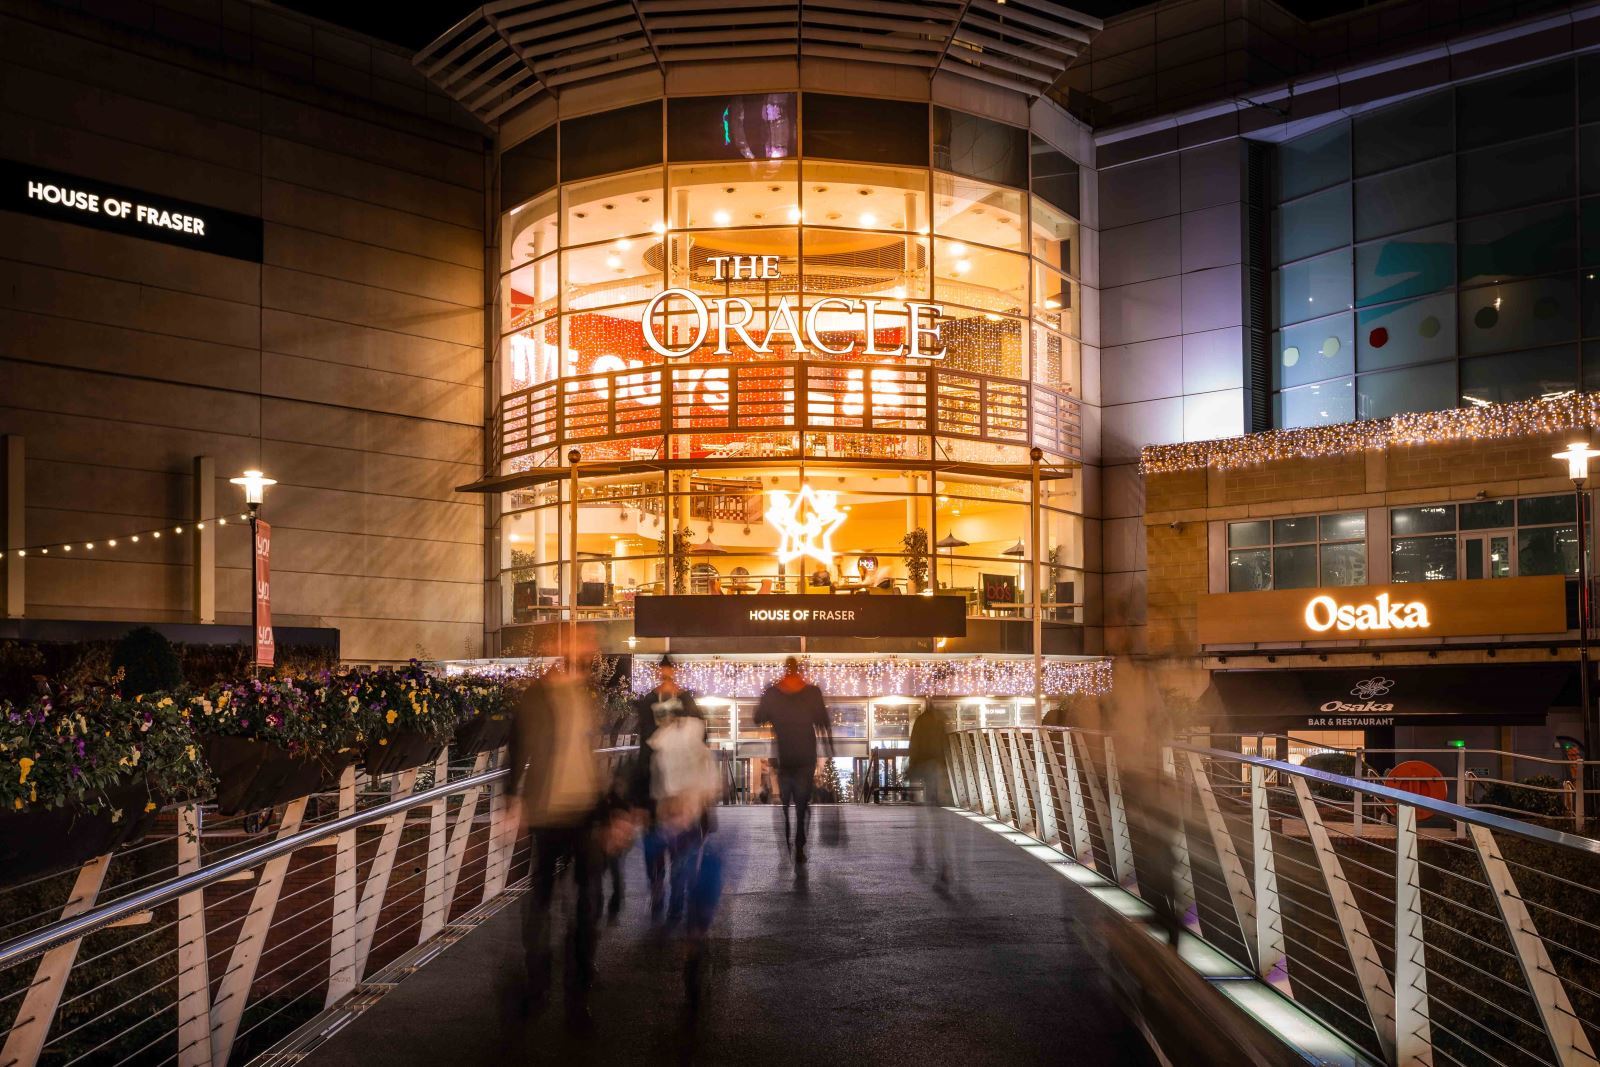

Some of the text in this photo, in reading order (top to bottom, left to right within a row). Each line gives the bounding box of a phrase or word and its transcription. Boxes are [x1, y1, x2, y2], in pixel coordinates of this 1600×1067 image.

[28, 181, 205, 235] HOUSE OF FRASER
[707, 255, 781, 281] THE
[642, 287, 948, 361] ORACLE
[748, 608, 855, 621] HOUSE OF FRASER
[1304, 592, 1431, 632] Osaka
[1320, 700, 1394, 712] Osaka
[1308, 718, 1394, 726] BAR & RESTAURANT
